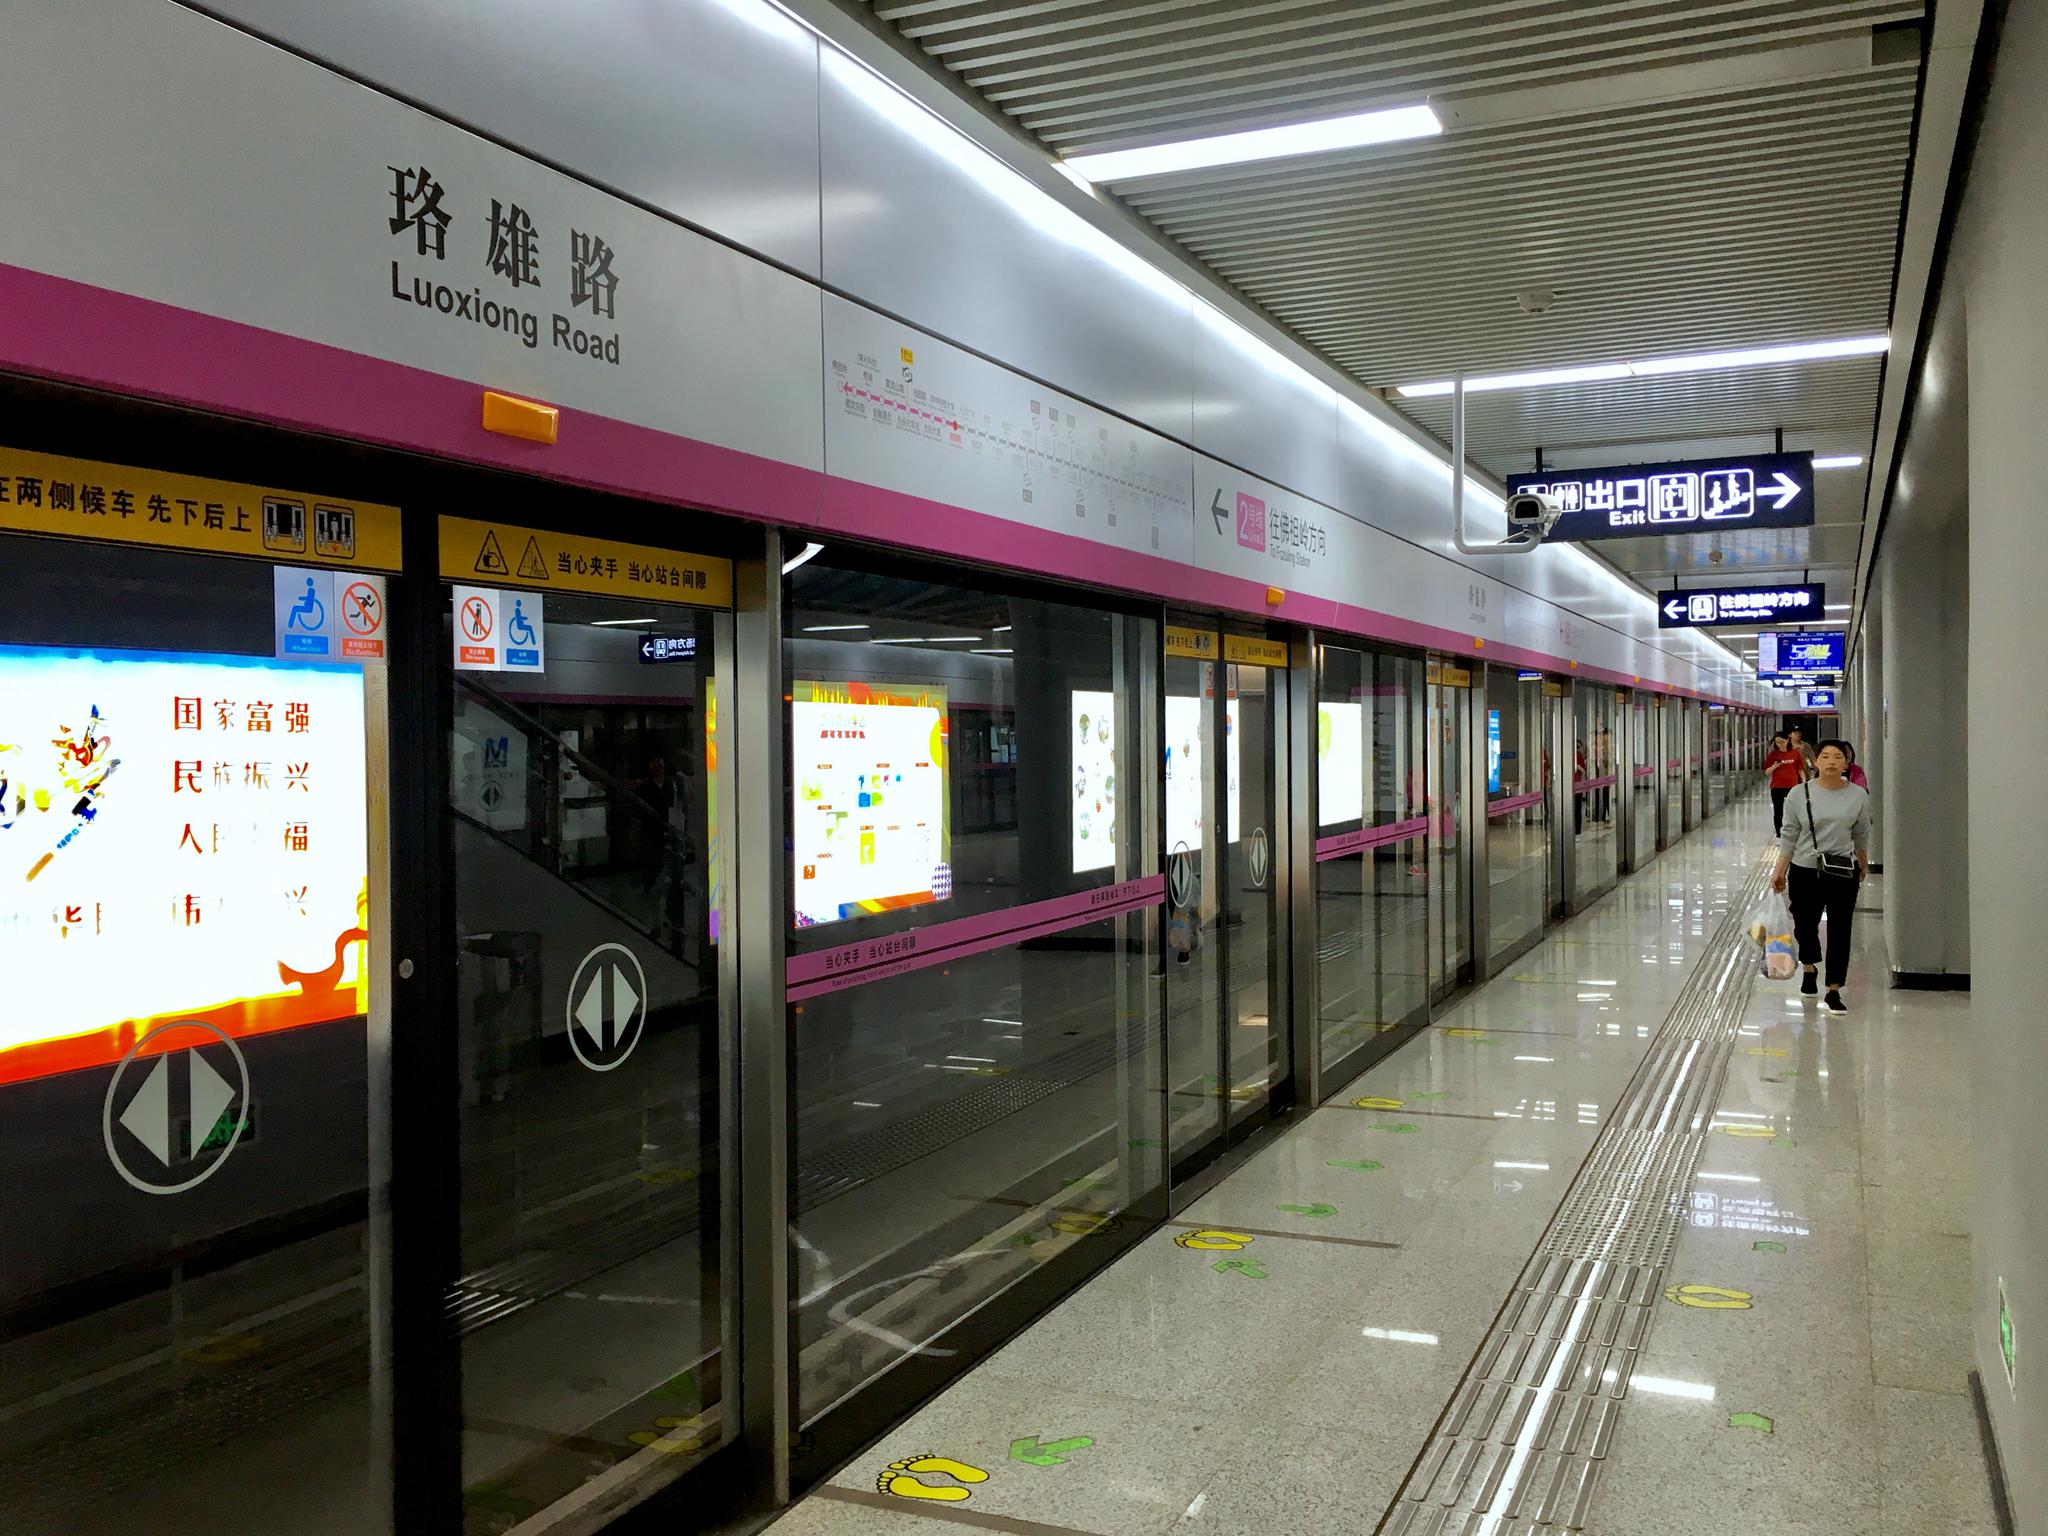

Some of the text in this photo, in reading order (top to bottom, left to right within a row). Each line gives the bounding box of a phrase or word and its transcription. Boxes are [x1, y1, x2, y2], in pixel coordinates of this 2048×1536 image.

[387, 165, 620, 319] 珞雄路
[391, 261, 620, 365] Luoxiong Road
[147, 494, 252, 533] 先下后上
[1584, 478, 1646, 511] 出口
[1239, 500, 1249, 541] 2
[1609, 509, 1646, 527] Exit
[558, 551, 707, 590] 当心夹手 当心站台间隙
[174, 696, 309, 733] 国家富强
[174, 760, 309, 793] 民族振兴
